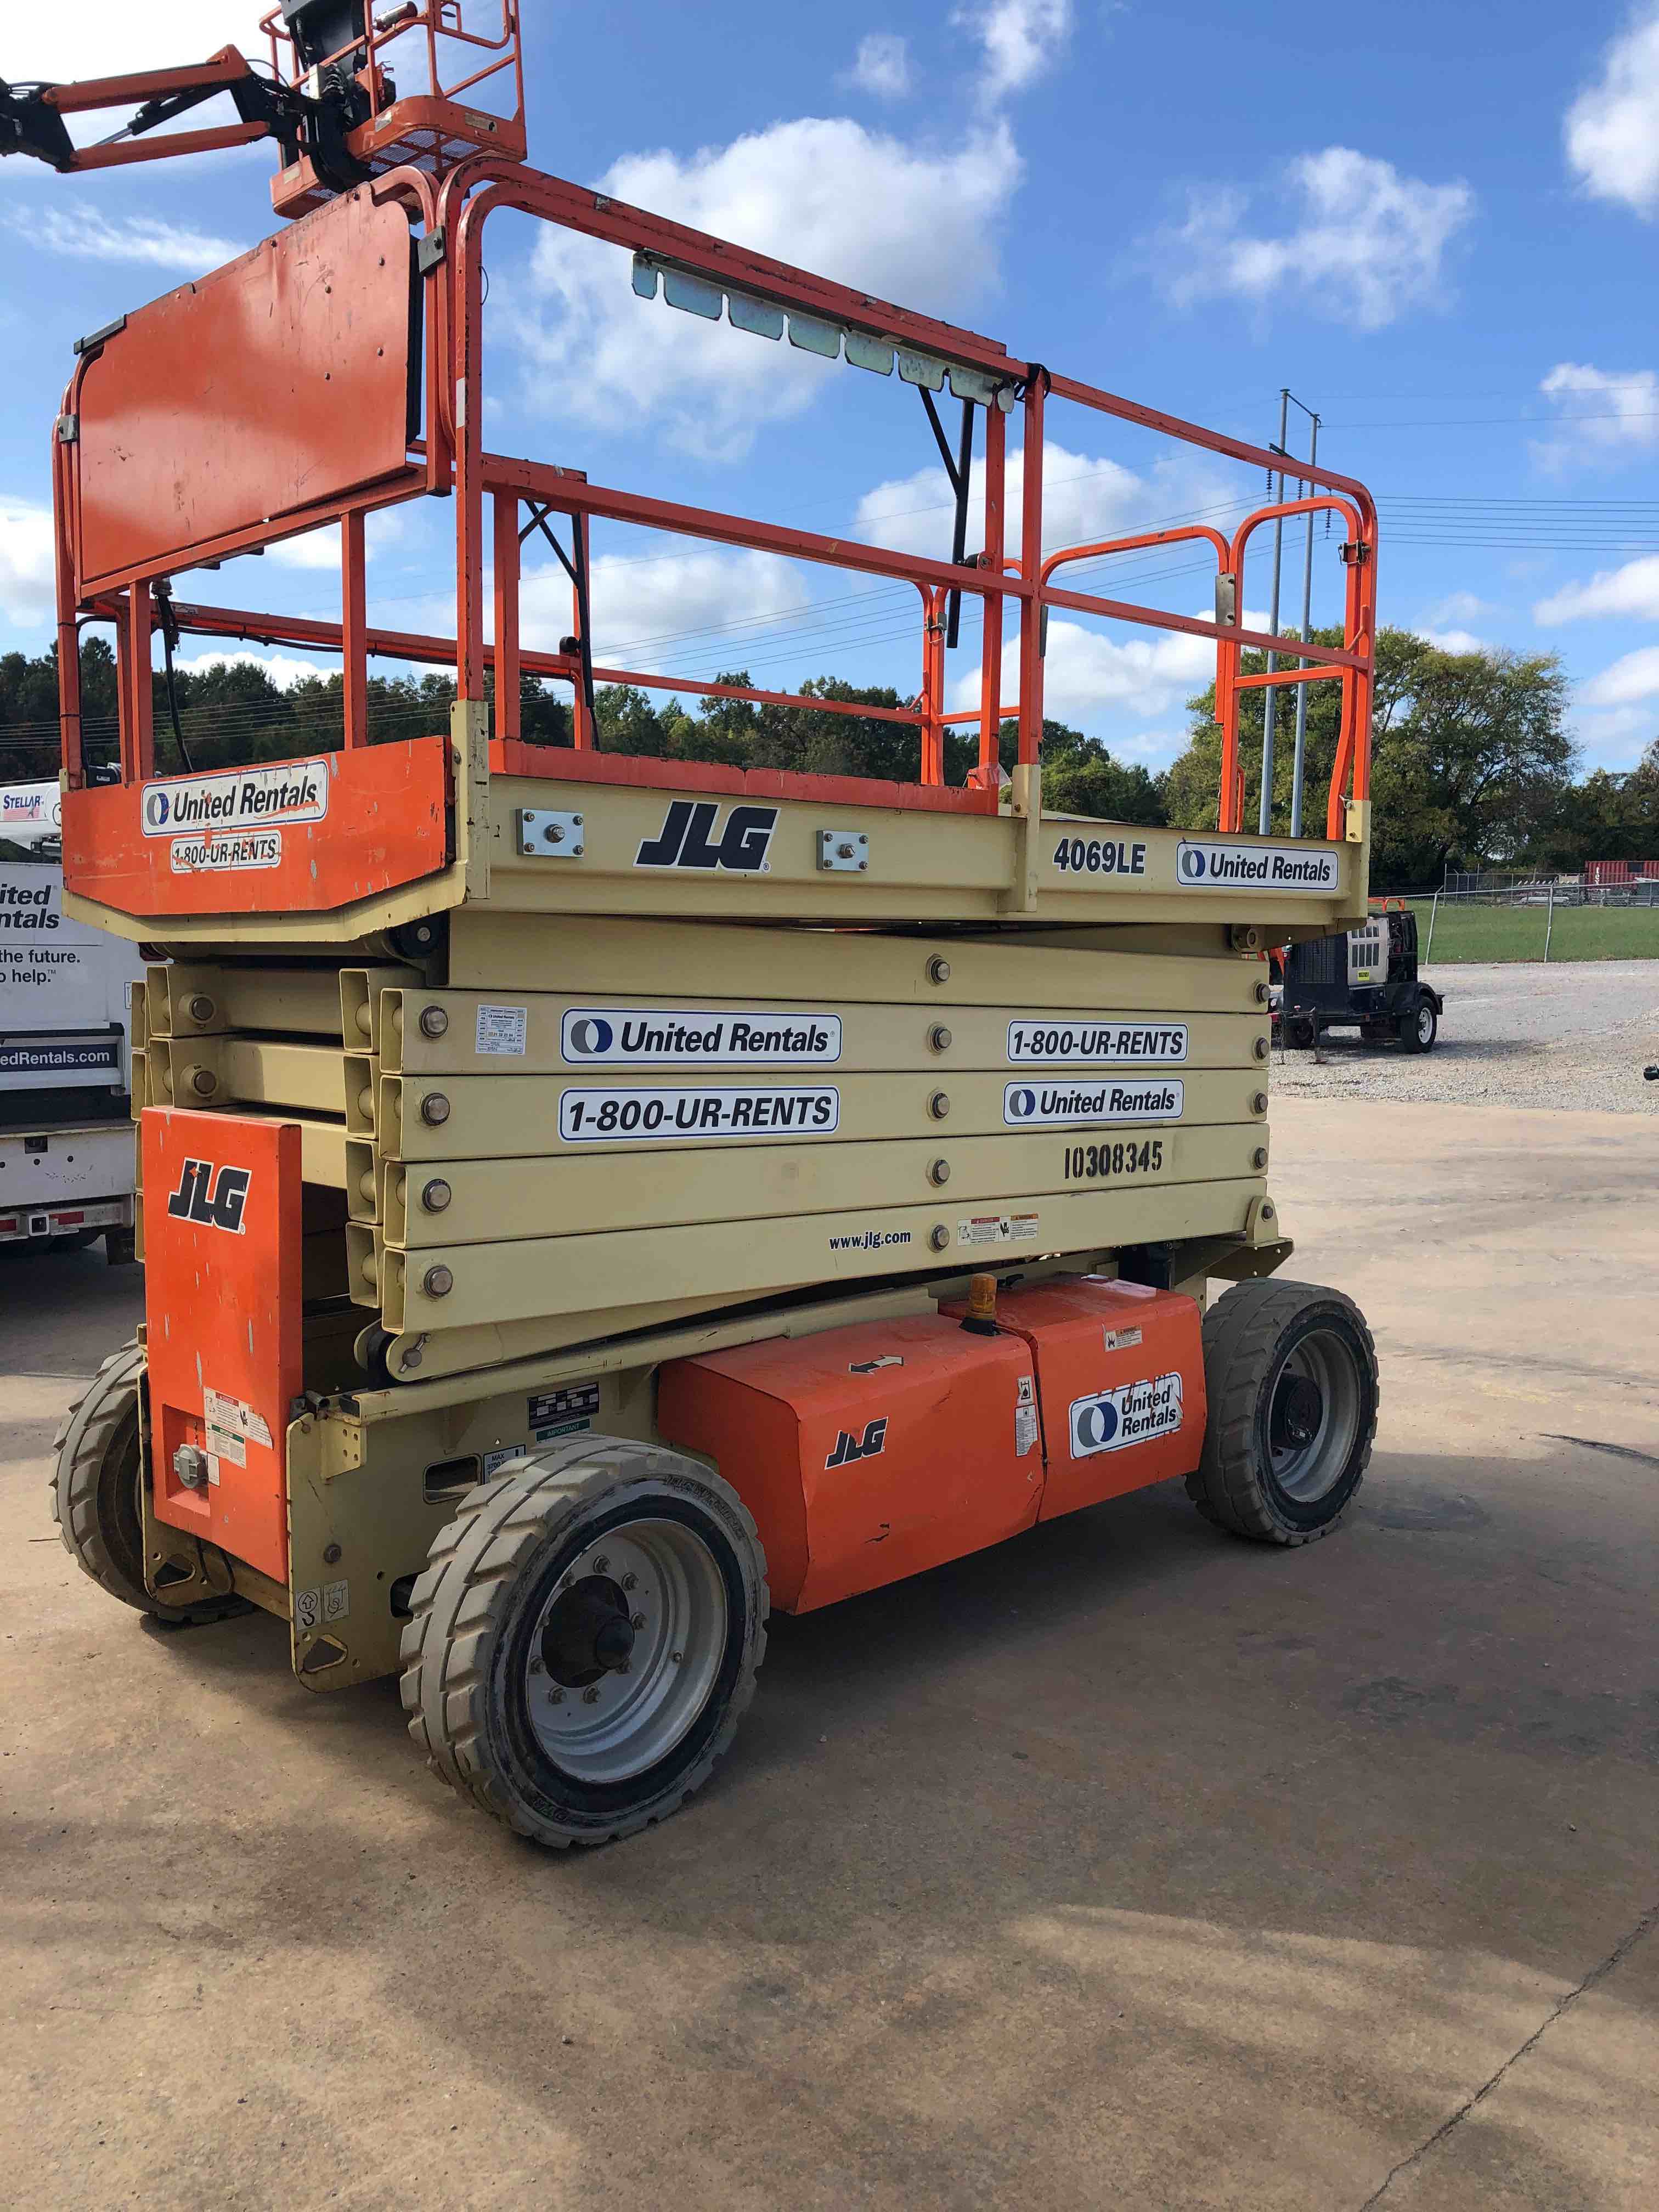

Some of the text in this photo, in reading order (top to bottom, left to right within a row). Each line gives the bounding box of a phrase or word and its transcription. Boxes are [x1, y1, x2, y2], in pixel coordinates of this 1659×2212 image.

[3, 795, 40, 809] STELLAR
[173, 775, 317, 822] United Rentals
[636, 800, 780, 870] JLG
[174, 838, 275, 866] 1-800-UR-RENTS
[1054, 838, 1146, 874] 4069LE
[1210, 853, 1330, 882] United Rentals
[29, 950, 80, 963] future.
[621, 1022, 828, 1052] United Rentals
[1014, 1031, 1183, 1055] 1-800-UR-RENTS
[569, 1096, 831, 1132] 1-800-UR-RENTS
[1040, 1088, 1175, 1115] United Rentals
[1065, 1141, 1163, 1180] 10308345
[168, 1158, 251, 1233] JLG
[830, 1232, 911, 1250] www.jlg.com
[1121, 1385, 1171, 1415] United
[547, 1423, 580, 1437] IMPORTANT
[1121, 1406, 1176, 1437] Rentals
[826, 1418, 888, 1469] JLG
